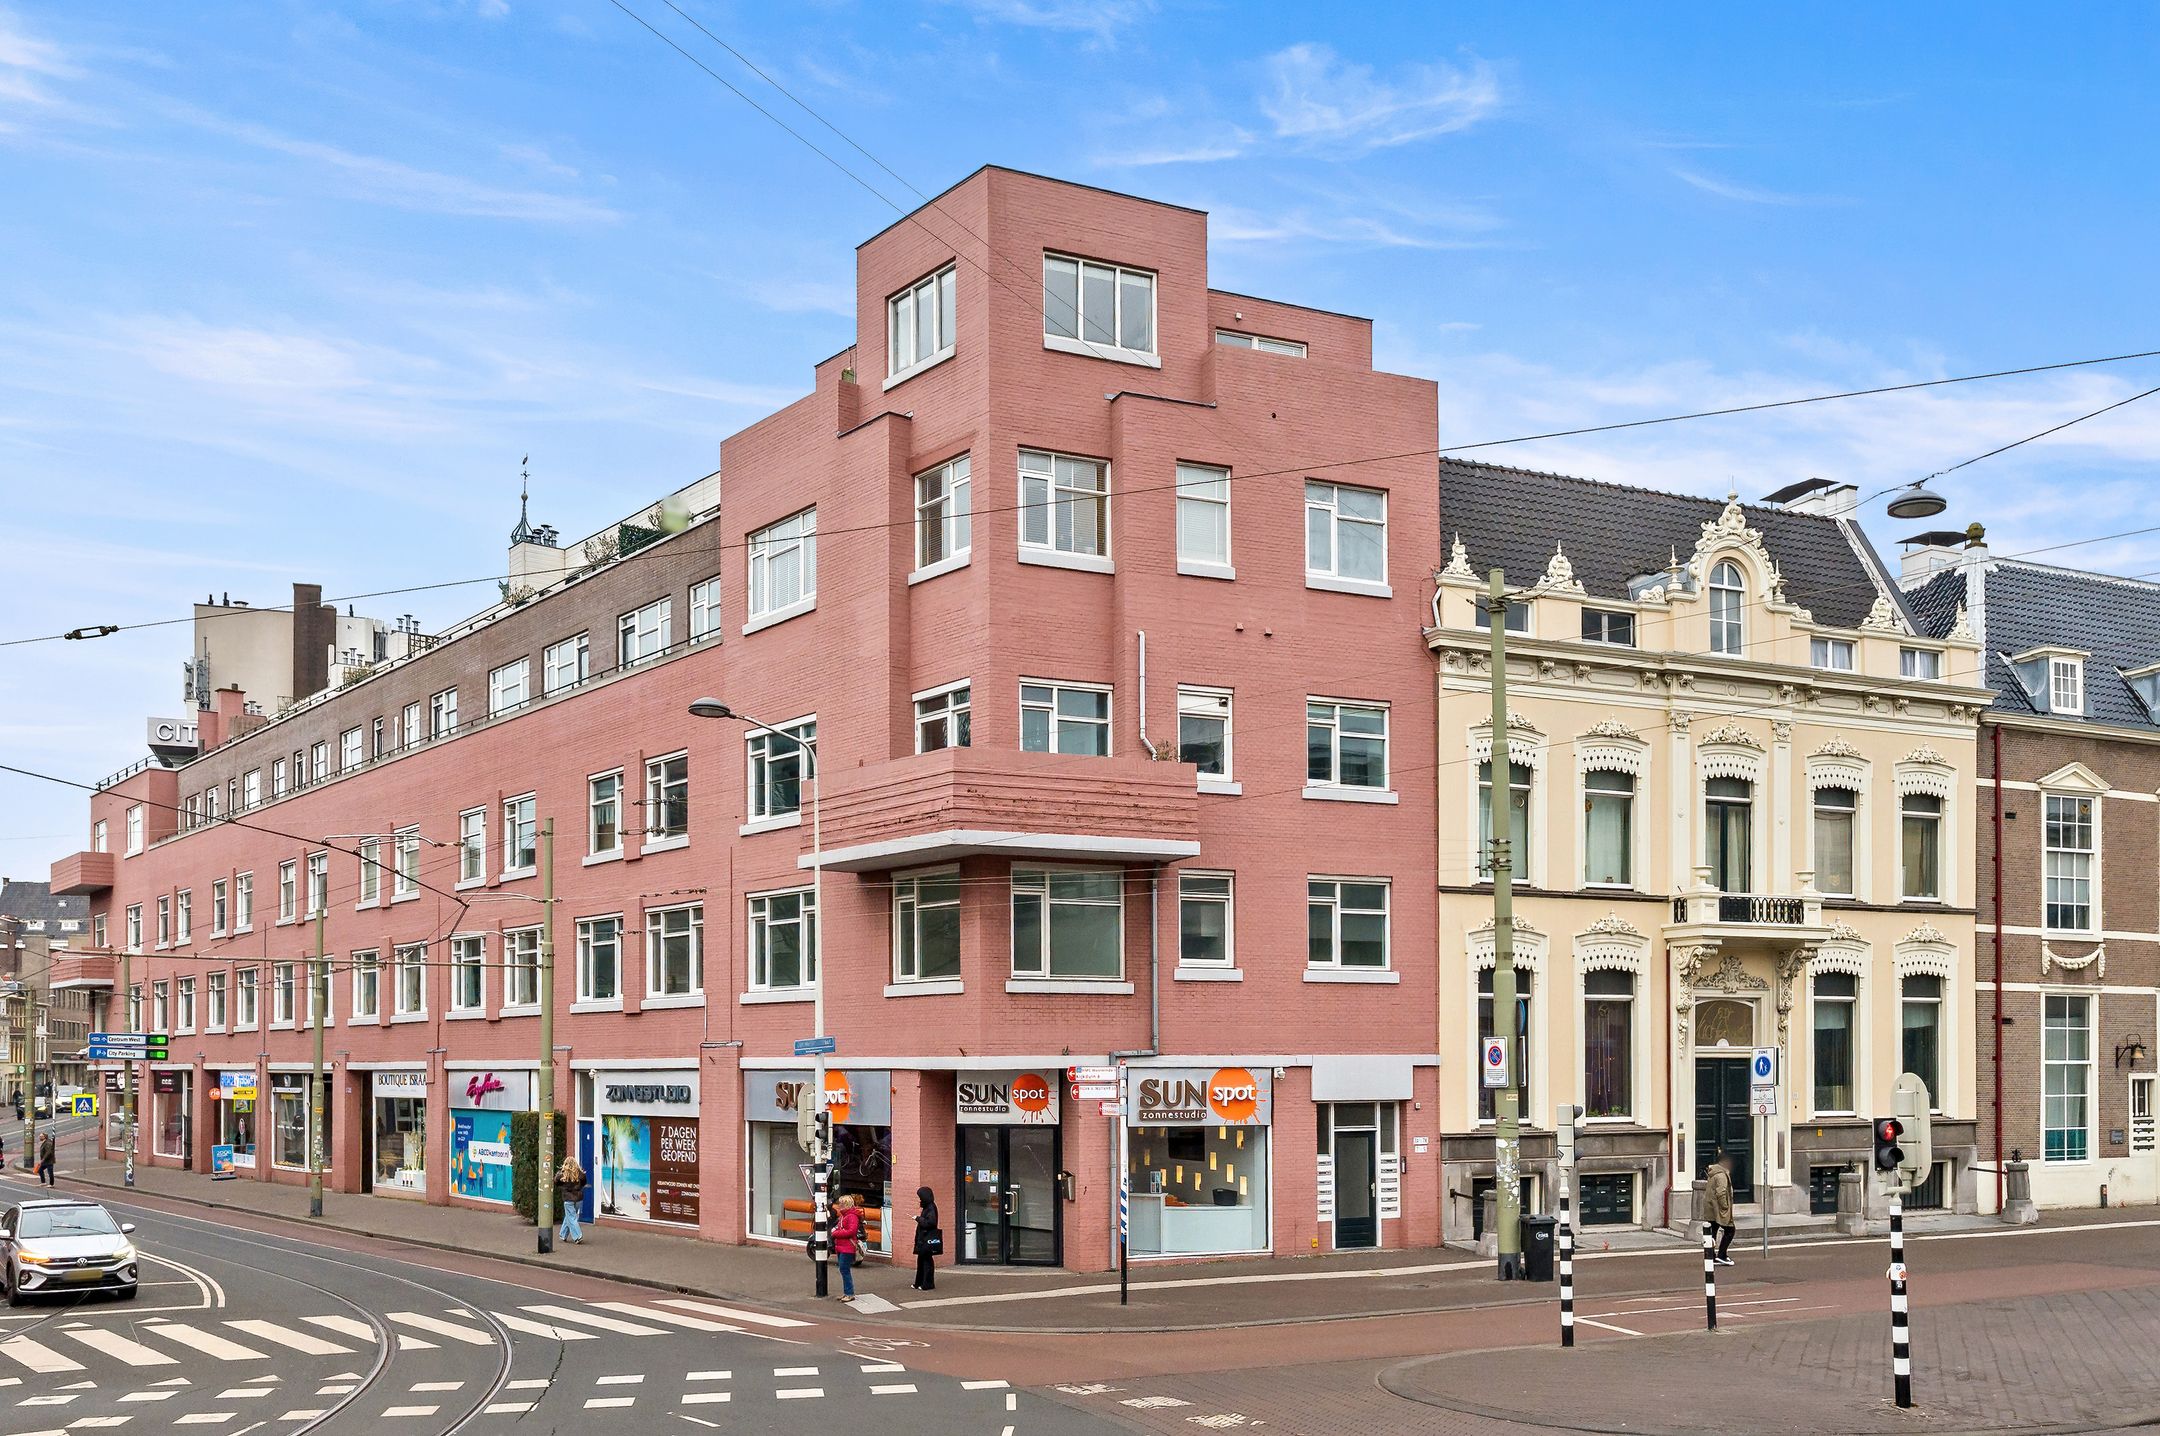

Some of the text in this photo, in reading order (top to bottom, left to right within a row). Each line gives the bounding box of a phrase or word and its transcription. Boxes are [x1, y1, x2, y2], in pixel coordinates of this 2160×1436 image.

[378, 1074, 408, 1087] BOUTIQUE
[775, 1081, 805, 1111] SU
[959, 1083, 1046, 1104] SUN spot
[1139, 1078, 1256, 1109] SUN spot
[1142, 1110, 1207, 1119] zonnestudio
[661, 1126, 697, 1139] 7 DAGEN
[661, 1138, 697, 1151] PER WEEK
[661, 1150, 697, 1163] GEOPEND
